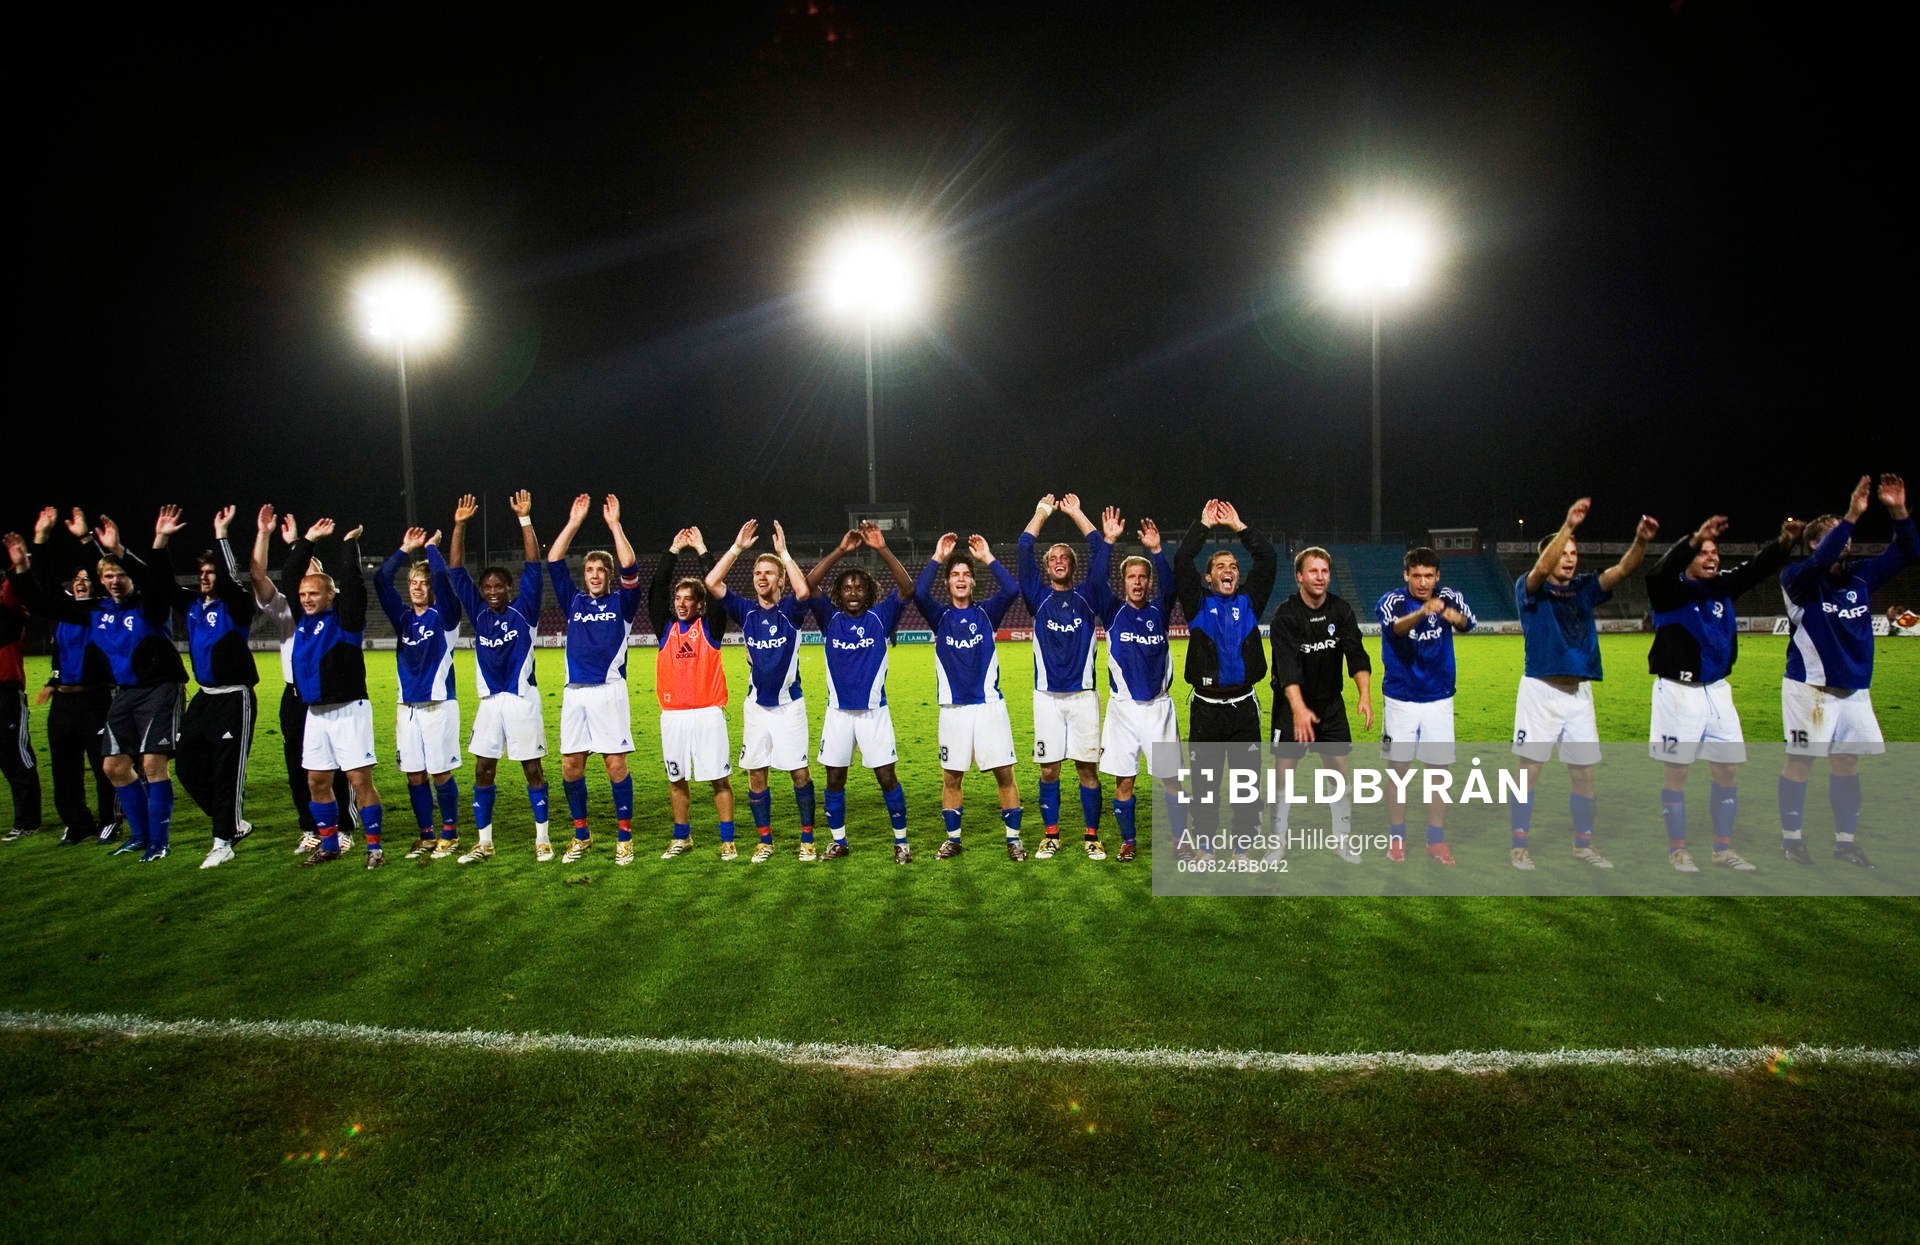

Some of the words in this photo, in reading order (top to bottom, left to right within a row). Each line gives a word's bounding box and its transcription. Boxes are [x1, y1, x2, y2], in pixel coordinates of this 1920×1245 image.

[832, 638, 875, 650] SHARP
[1036, 741, 1046, 757] 3
[1661, 734, 1679, 755] 12
